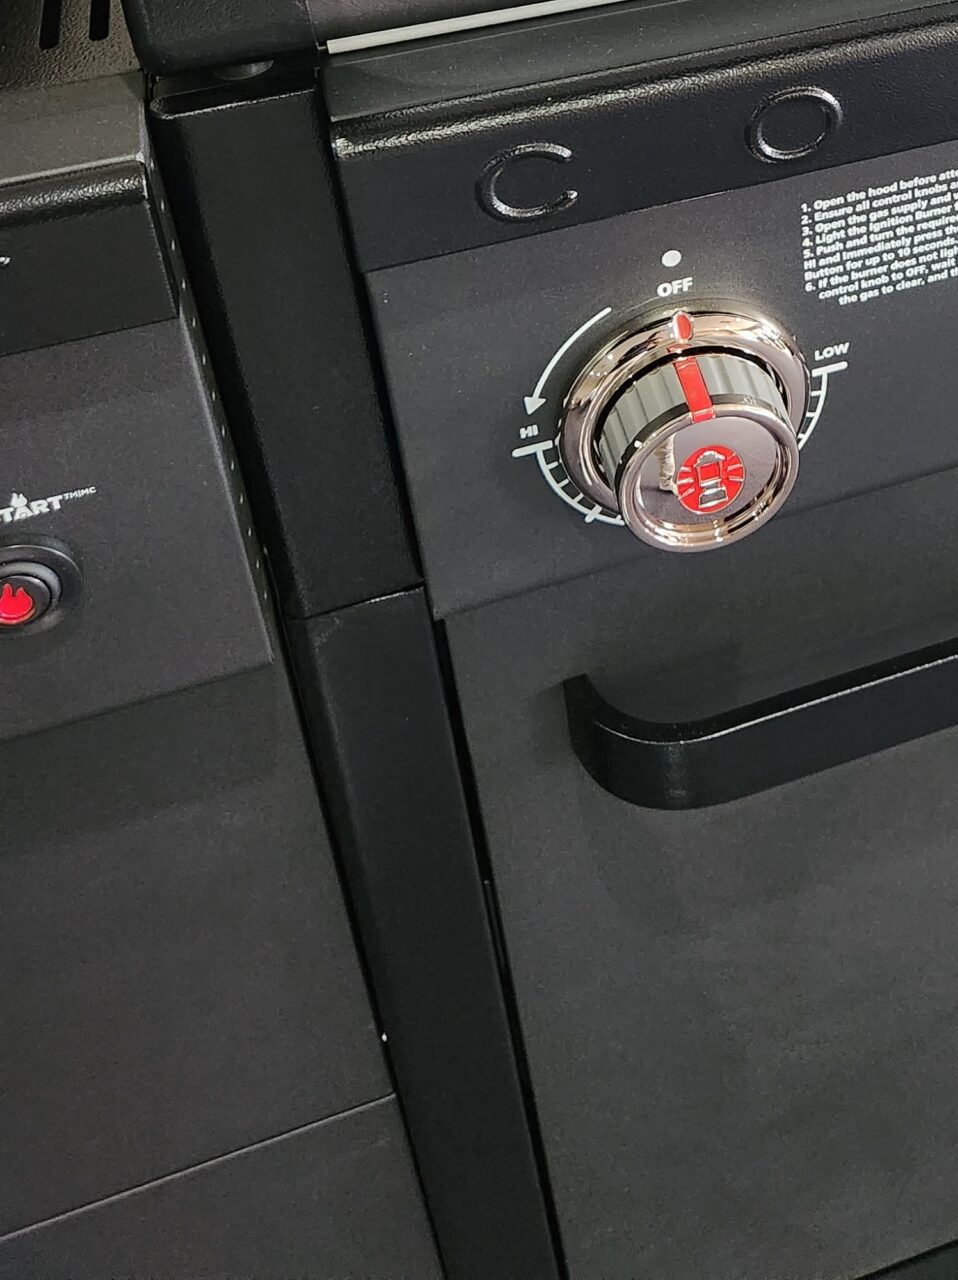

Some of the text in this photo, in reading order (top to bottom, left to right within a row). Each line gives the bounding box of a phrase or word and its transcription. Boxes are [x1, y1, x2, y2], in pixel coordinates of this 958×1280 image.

[801, 203, 812, 213] 1.
[813, 196, 844, 211] Open
[846, 191, 866, 202] the
[868, 182, 898, 197] hood
[899, 174, 937, 190] before
[801, 215, 812, 225] 2.
[814, 205, 853, 222] Ensure
[855, 199, 870, 212] all
[871, 190, 912, 208] control
[914, 183, 948, 198] knobs
[801, 226, 813, 237] 3.
[814, 219, 846, 233] Open
[847, 214, 867, 225] the
[868, 209, 889, 222] gas
[890, 199, 928, 215] supply
[929, 192, 952, 205] and
[802, 237, 814, 248] 4.
[815, 229, 846, 245] Light
[847, 225, 867, 237] the
[869, 214, 914, 233] Ignition
[914, 205, 953, 221] Burner
[803, 248, 814, 259] 5.
[816, 241, 844, 256] Push
[845, 235, 868, 249] and
[869, 230, 894, 242] turn
[895, 225, 915, 236] the
[803, 259, 816, 270] HI
[818, 252, 840, 266] and
[913, 230, 943, 245] press
[804, 237, 958, 281] Button for up to 10 seconds.
[656, 277, 694, 298] OFF
[804, 282, 816, 292] 6.
[818, 278, 828, 289] If
[829, 274, 849, 286] the
[850, 264, 889, 280] burner
[890, 258, 917, 271] does
[918, 251, 939, 263] not
[819, 281, 859, 299] control
[860, 274, 889, 289] knob
[890, 272, 904, 281] to
[905, 264, 929, 277] OFF,
[930, 257, 956, 271] wait
[838, 294, 858, 306] the
[859, 289, 880, 302] gas
[881, 285, 894, 295] to
[895, 278, 925, 291] clear,
[927, 269, 949, 283] and
[814, 341, 850, 362] LOW
[519, 424, 540, 439] HI
